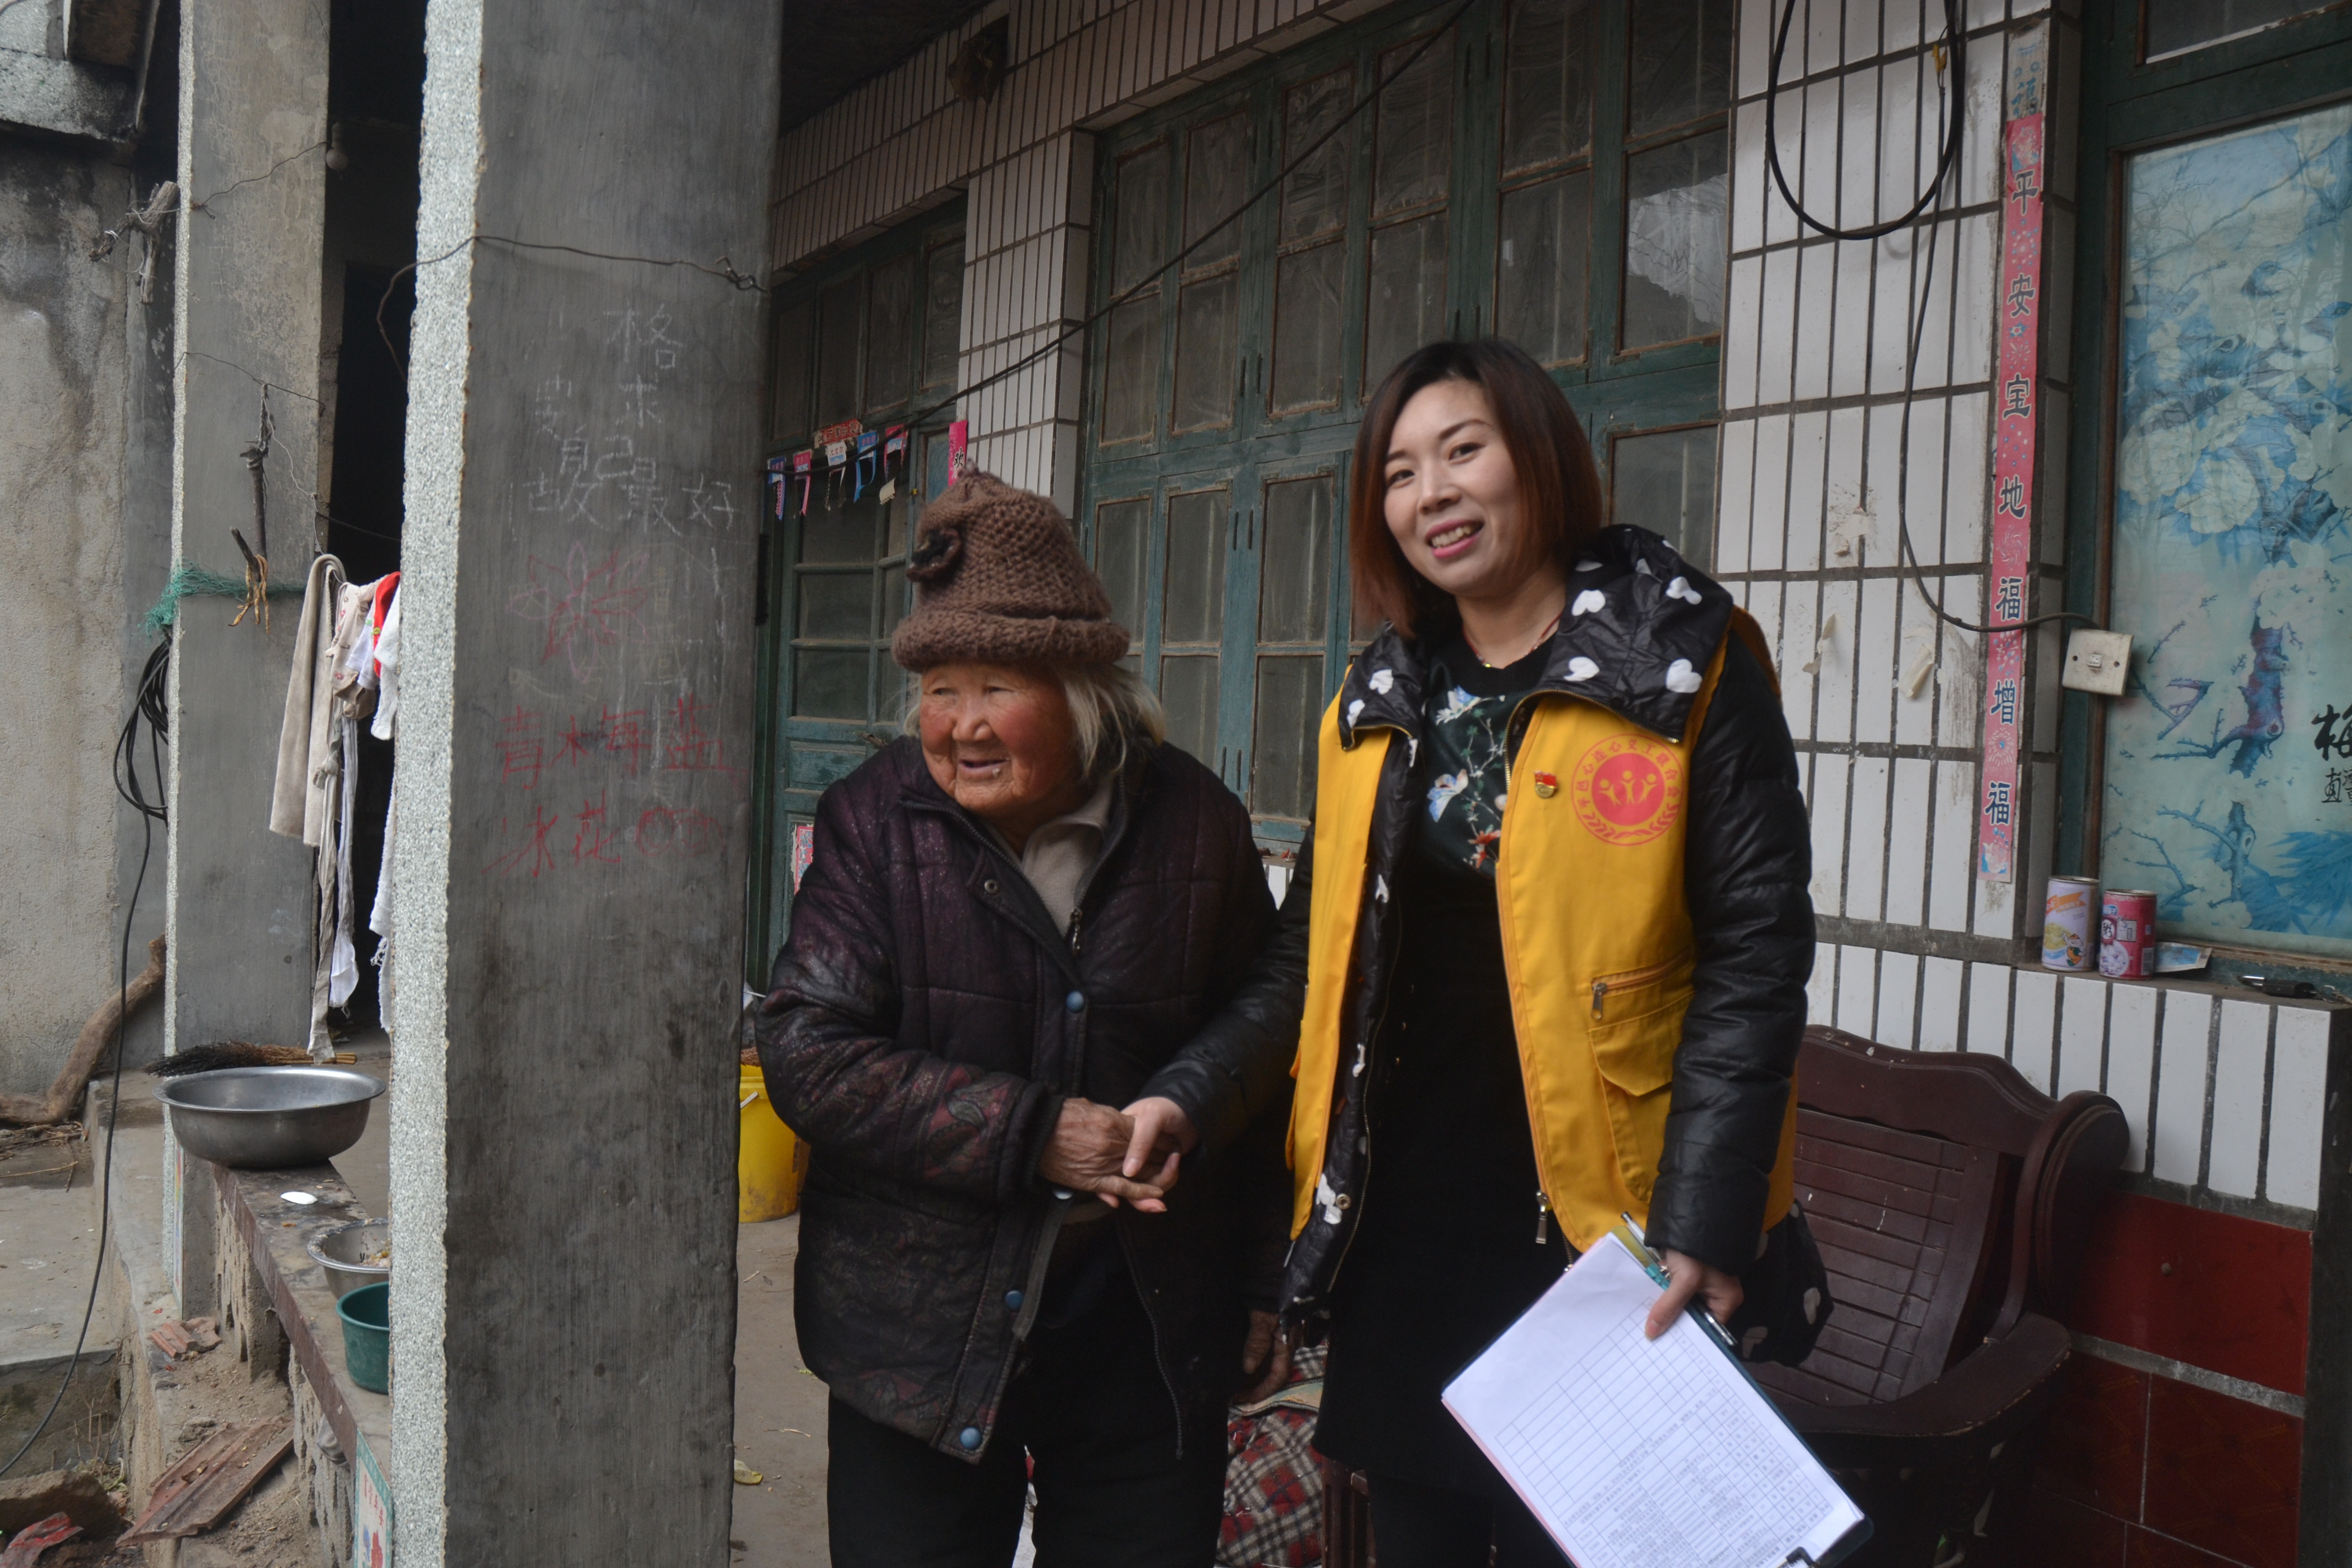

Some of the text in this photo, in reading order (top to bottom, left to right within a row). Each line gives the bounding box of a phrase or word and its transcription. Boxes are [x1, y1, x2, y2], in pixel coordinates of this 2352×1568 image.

[1984, 169, 2041, 826] 平安宝地福增福
